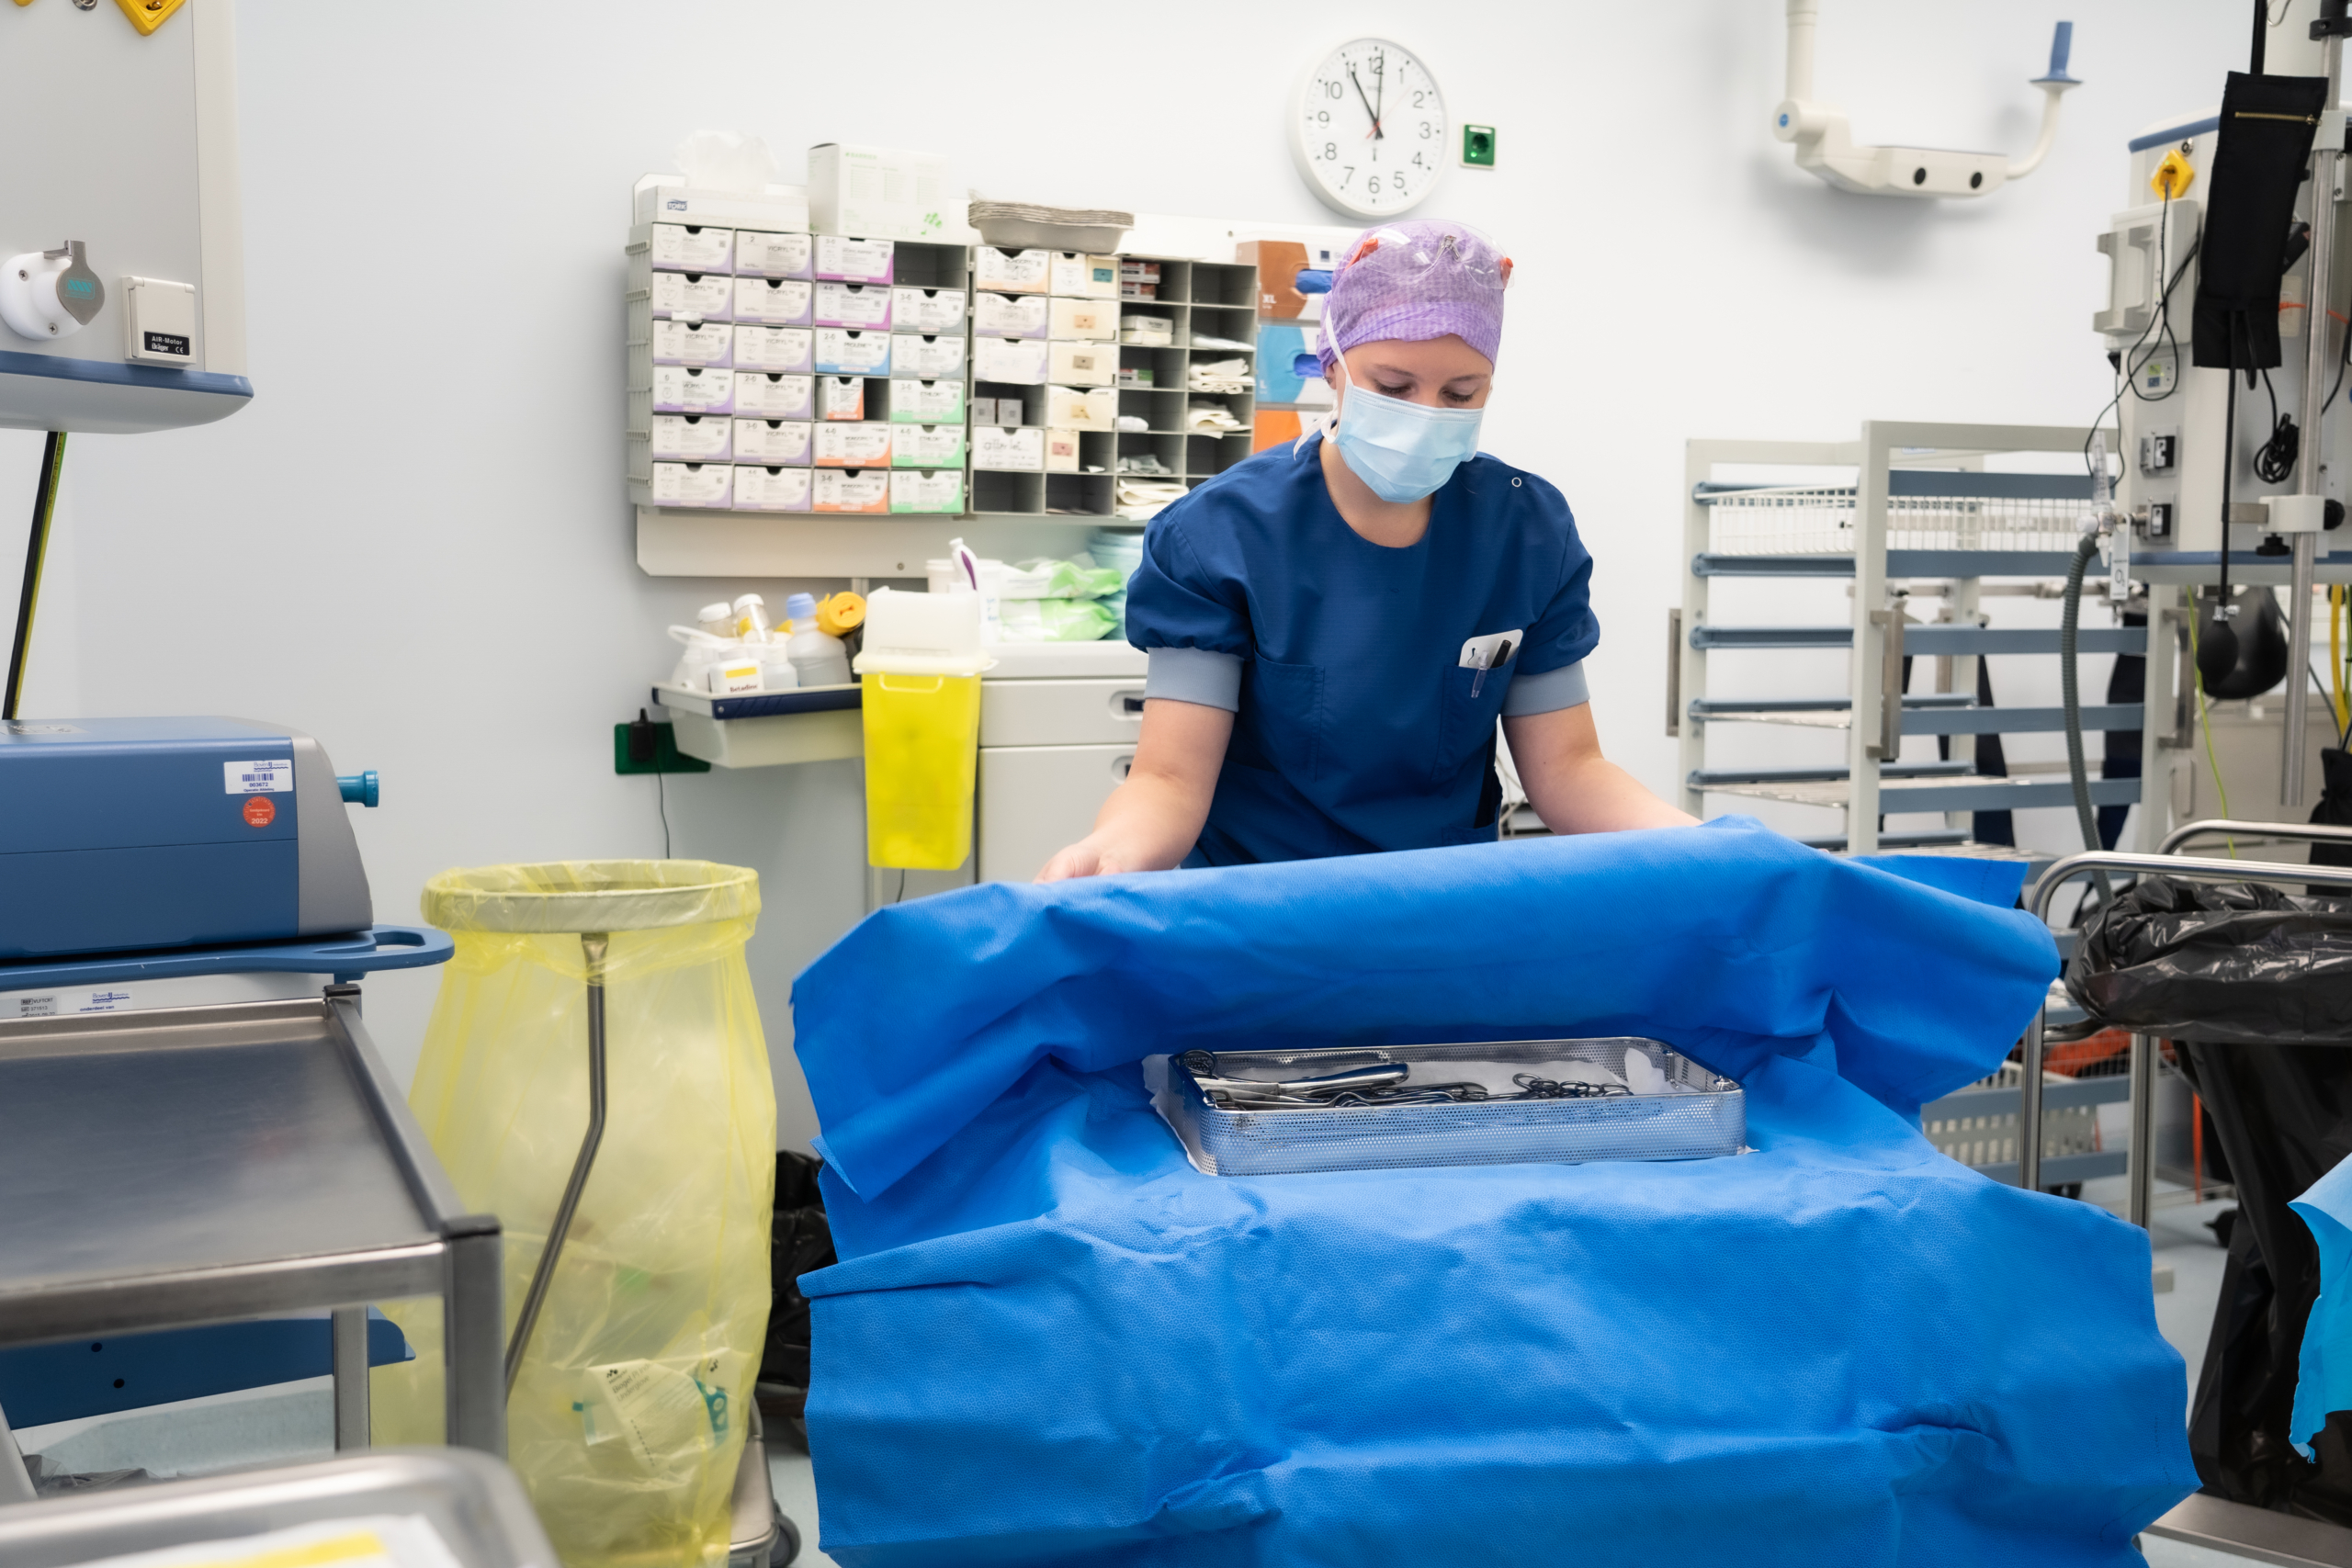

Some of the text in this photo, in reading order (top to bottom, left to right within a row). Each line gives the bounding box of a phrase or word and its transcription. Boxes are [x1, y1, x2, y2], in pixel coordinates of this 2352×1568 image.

[1368, 56, 1384, 75] 12
[1399, 67, 1404, 85] 1
[1325, 81, 1343, 99] 10
[1413, 90, 1424, 108] 2
[1317, 111, 1329, 129] 9
[1419, 121, 1431, 139] 3
[1325, 142, 1337, 160] 8
[1411, 152, 1423, 169] 4
[1343, 166, 1355, 184] 7
[1393, 172, 1405, 189] 5
[1368, 175, 1380, 194] 6
[668, 200, 687, 211] TORK
[1262, 294, 1276, 304] XL
[152, 335, 183, 346] AIR-Motor
[152, 343, 169, 352] Dräger
[1260, 379, 1267, 389] L
[612, 1375, 633, 1393] Biogel
